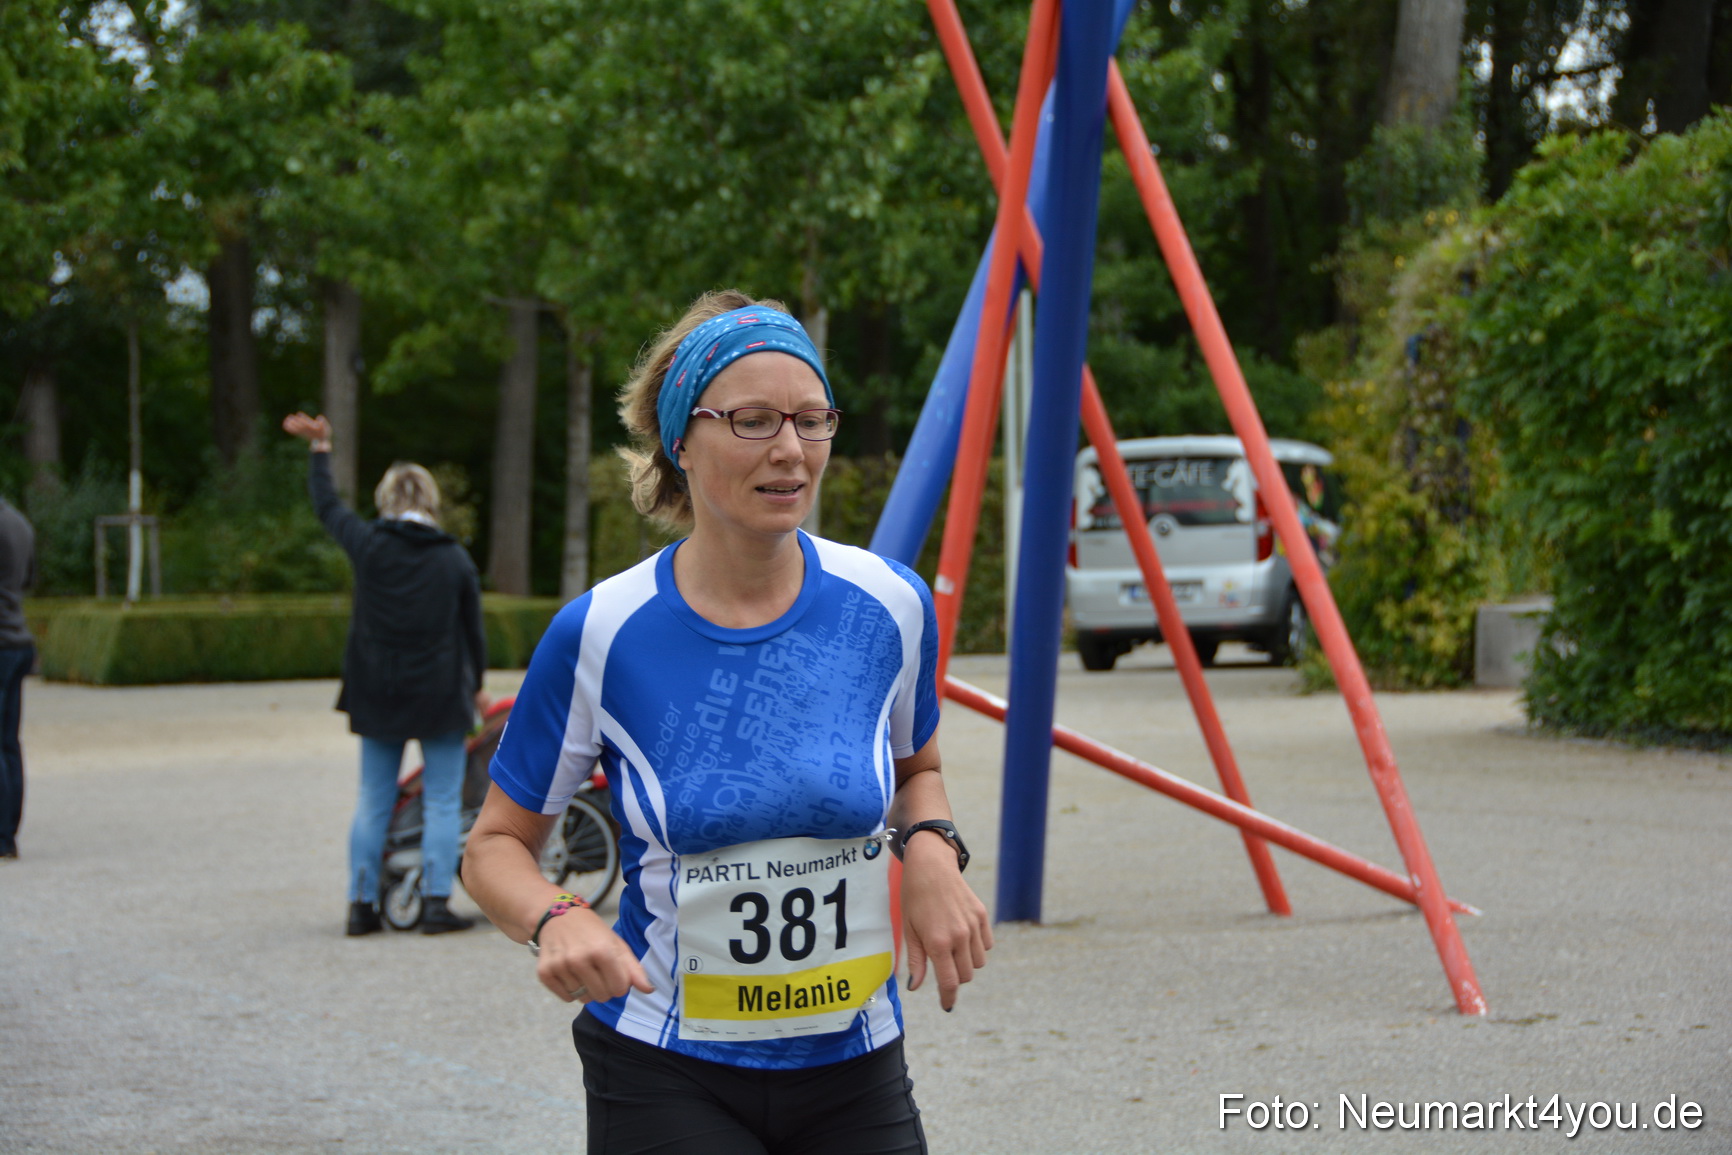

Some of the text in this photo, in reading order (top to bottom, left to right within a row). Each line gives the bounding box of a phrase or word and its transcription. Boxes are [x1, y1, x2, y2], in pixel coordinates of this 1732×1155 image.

[650, 701, 682, 769] Jeder
[686, 847, 858, 884] PARTL Neumarkt
[729, 877, 848, 965] 381
[689, 958, 698, 971] D
[738, 975, 850, 1012] Melanie
